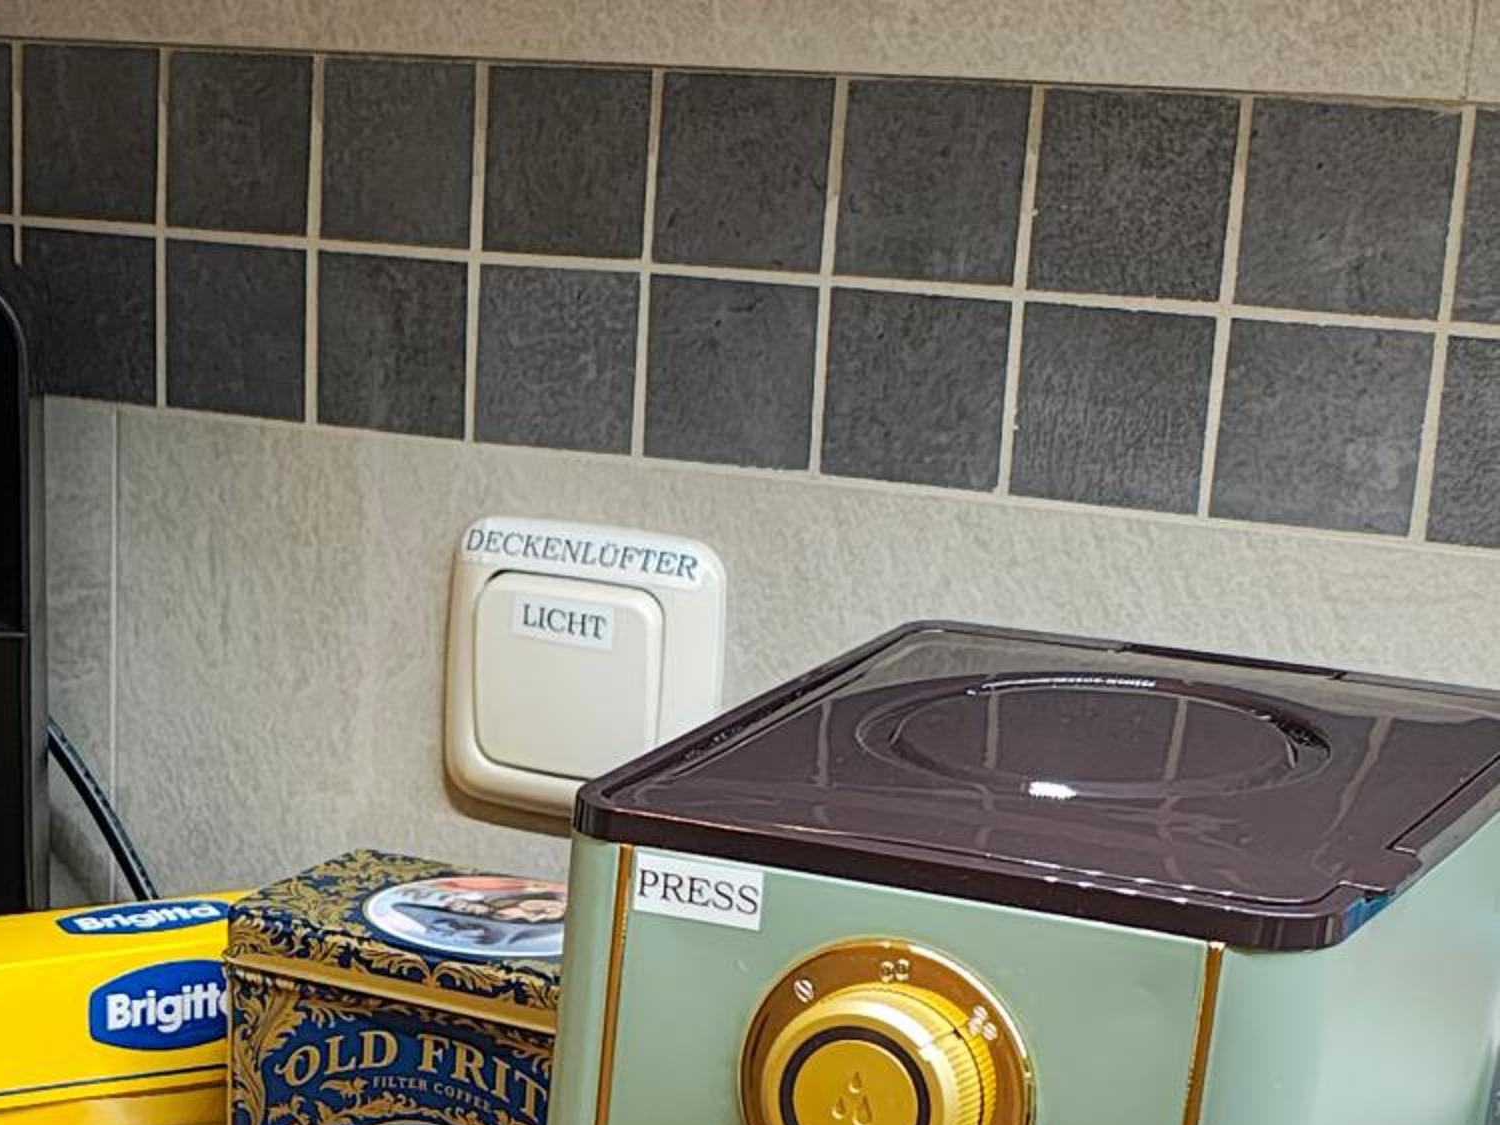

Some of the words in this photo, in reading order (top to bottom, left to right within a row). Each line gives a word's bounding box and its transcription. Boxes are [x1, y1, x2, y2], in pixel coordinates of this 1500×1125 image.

[522, 604, 607, 640] LICHT
[639, 869, 759, 914] PRESS
[73, 903, 221, 931] Brigitta
[275, 1030, 399, 1087] OLD
[373, 1076, 427, 1091] FILTER
[434, 1083, 490, 1111] COFFEE
